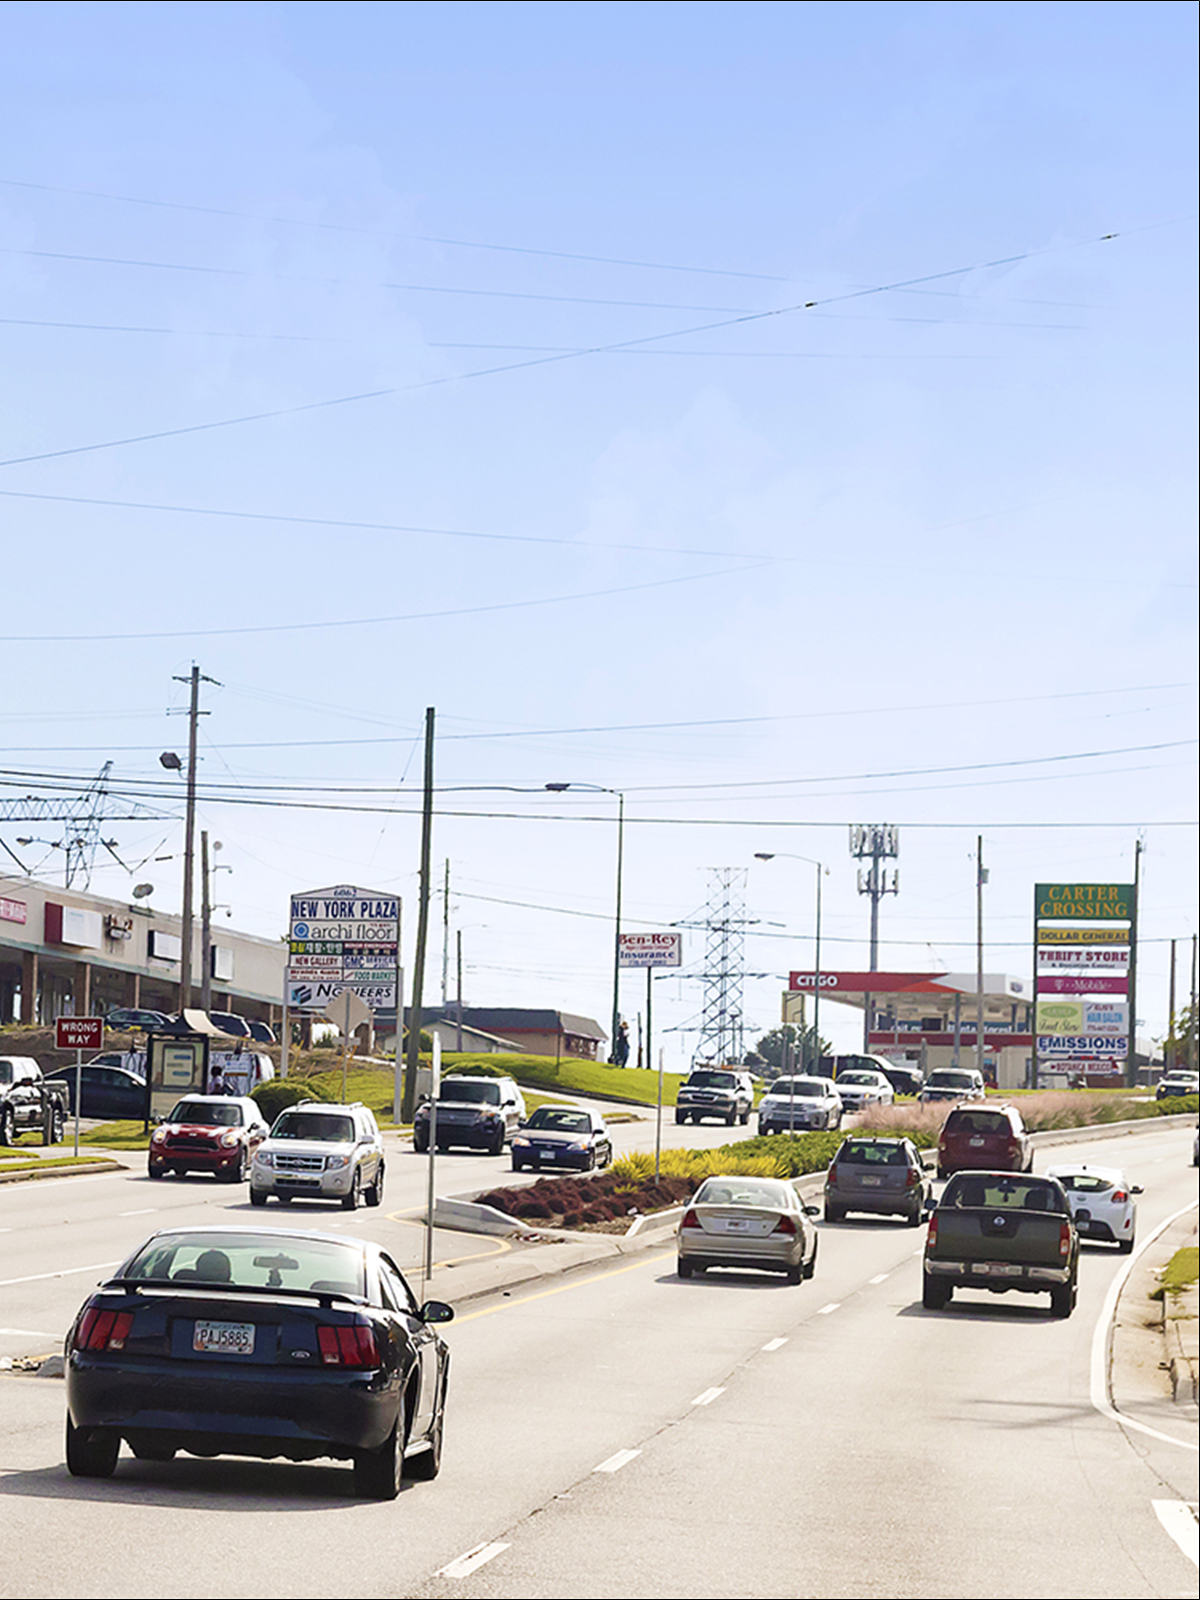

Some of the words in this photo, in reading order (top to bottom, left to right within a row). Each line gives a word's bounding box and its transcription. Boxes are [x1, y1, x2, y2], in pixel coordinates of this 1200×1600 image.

[1048, 886, 1119, 900] CARTER
[291, 901, 318, 917] NEW
[324, 901, 355, 918] YORK
[361, 901, 398, 918] PLAZA
[1040, 902, 1127, 916] CROSSING
[311, 924, 352, 939] archi
[357, 924, 393, 939] floor
[1040, 932, 1079, 940] DOLLAR
[1082, 932, 1127, 940] GENERAL
[619, 934, 677, 946] Ben-Rey
[620, 951, 675, 959] Insurance
[1039, 951, 1082, 961] THRIFT
[1086, 951, 1128, 962] STORE
[797, 975, 838, 987] CITGO
[317, 983, 392, 998] NGNEERS
[61, 1022, 98, 1033] WRONG
[68, 1034, 90, 1044] WAY
[1039, 1037, 1127, 1049] EMISSIONS
[200, 1329, 249, 1347] PAJ5885
